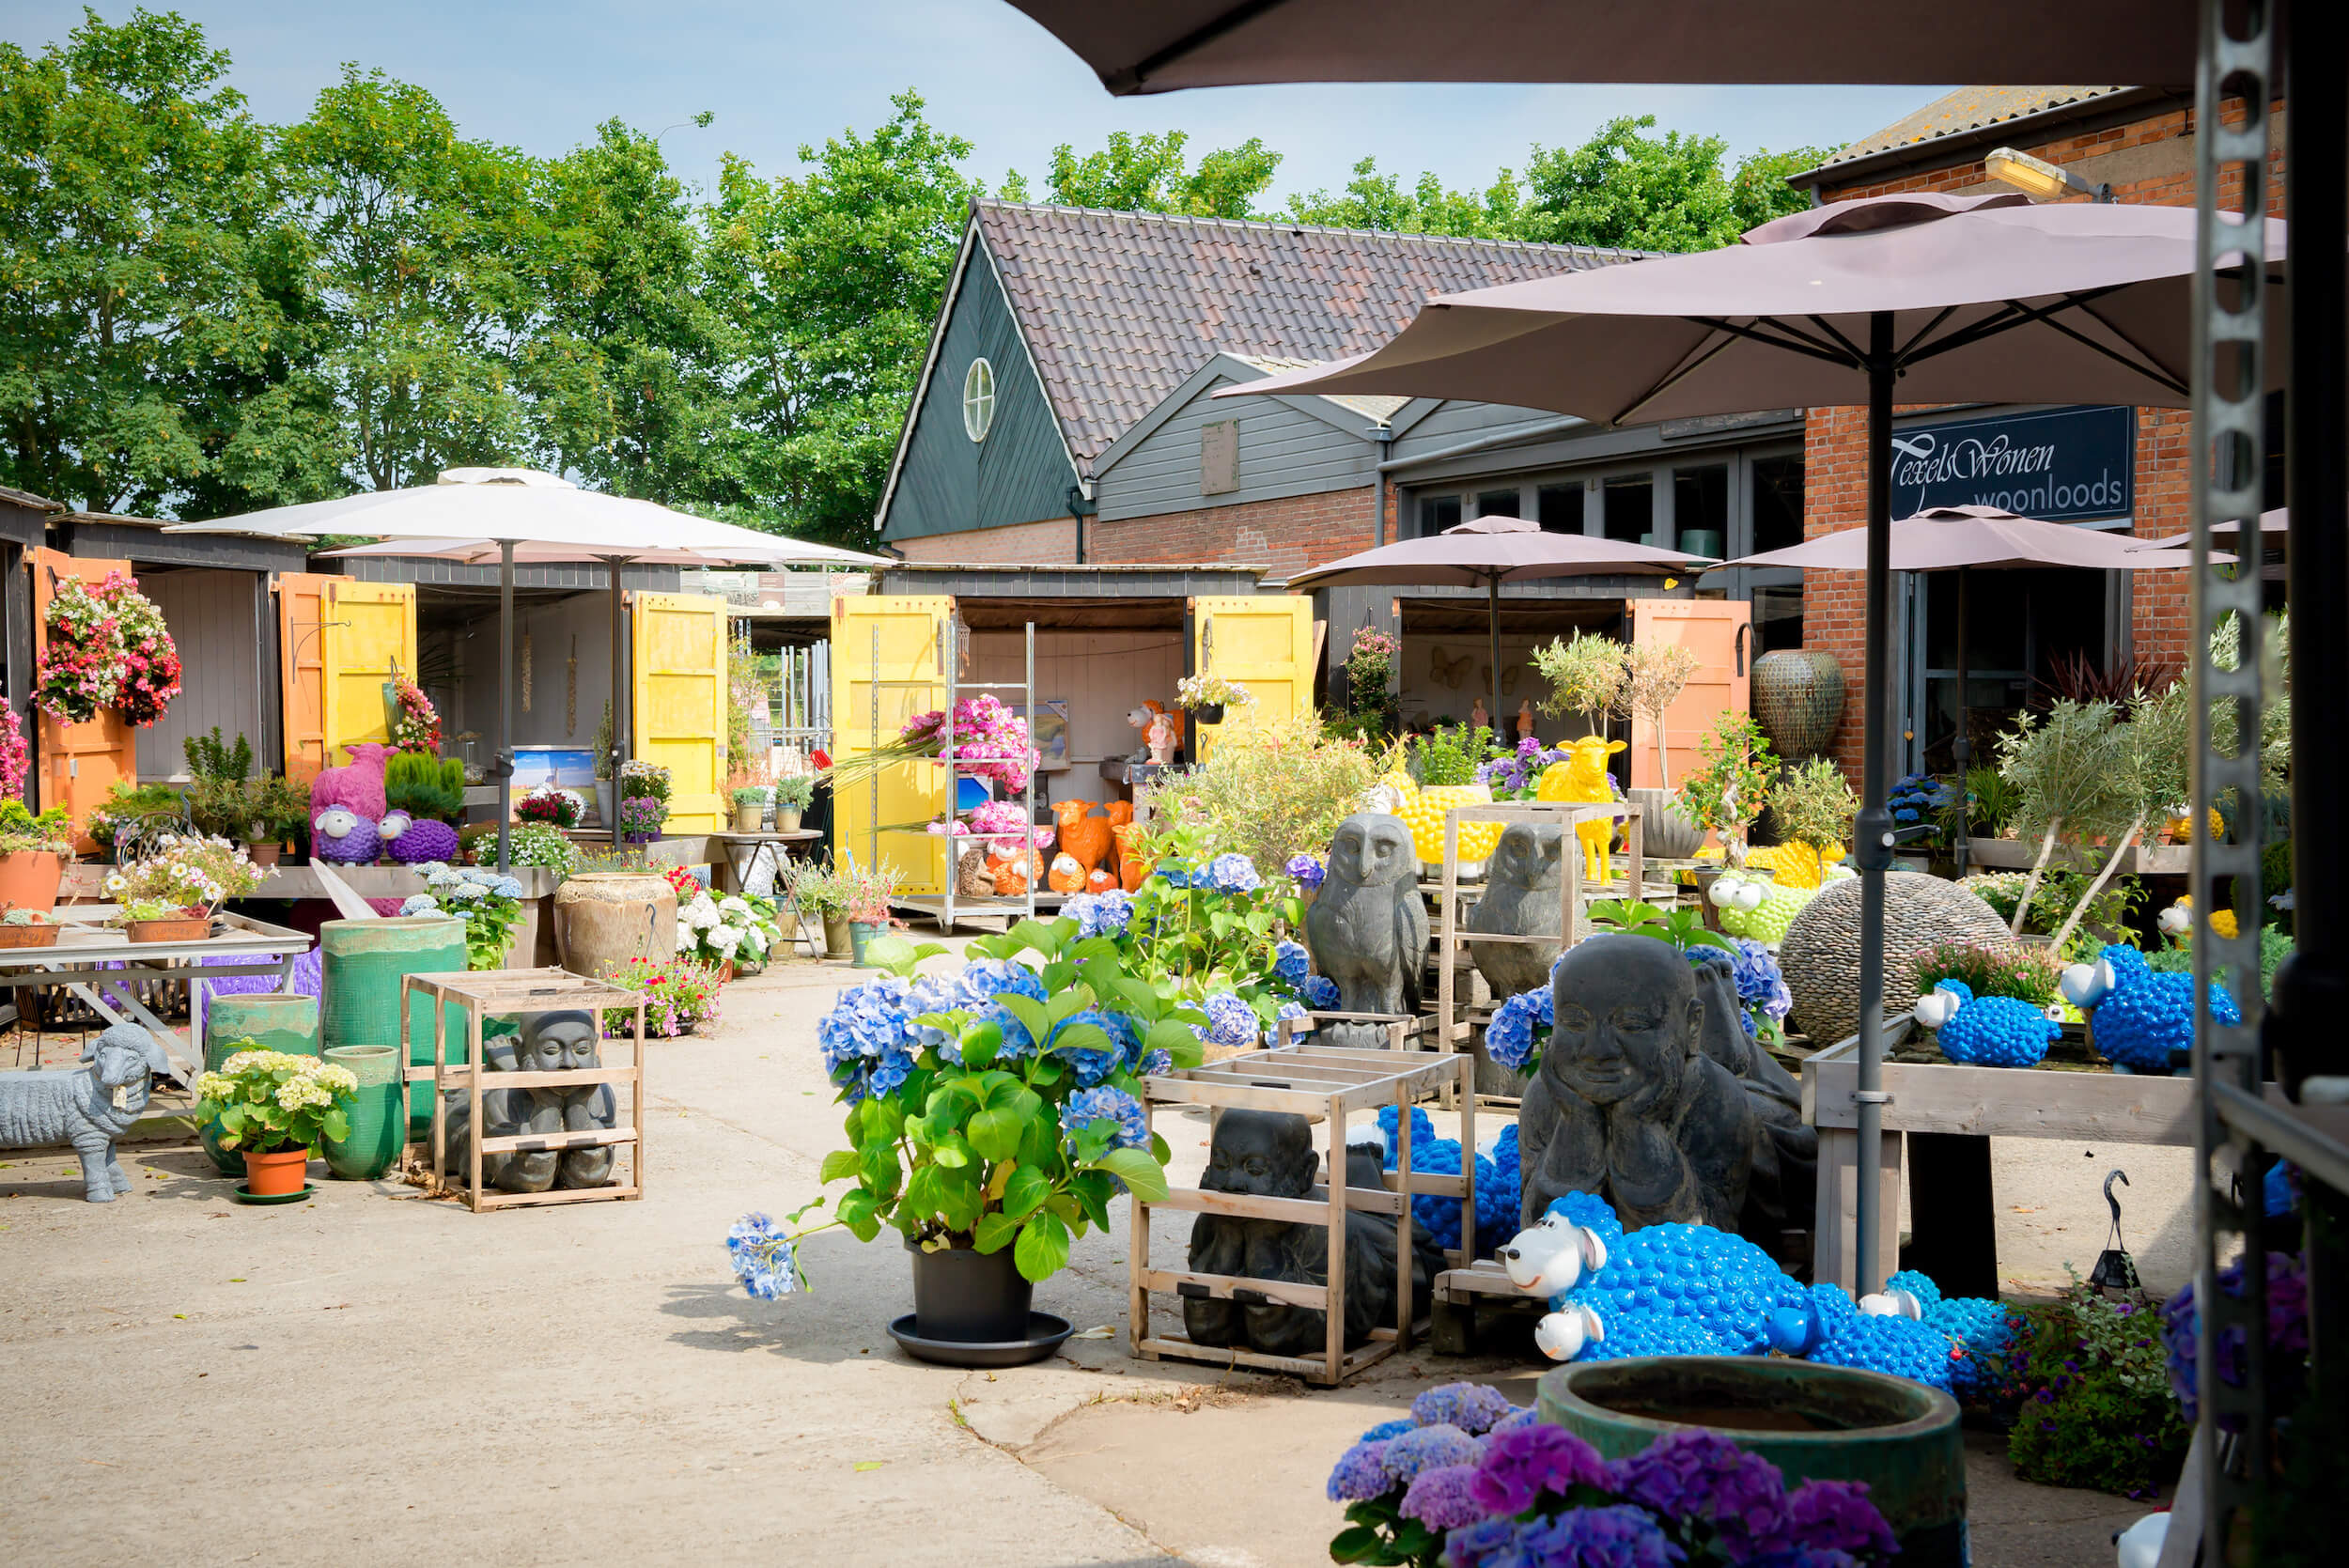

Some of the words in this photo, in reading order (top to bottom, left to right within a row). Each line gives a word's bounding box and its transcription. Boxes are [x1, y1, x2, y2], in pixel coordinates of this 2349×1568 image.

[1890, 433, 1956, 514] Texels
[1953, 434, 2055, 478] Wonen
[1974, 468, 2122, 512] woonloods
